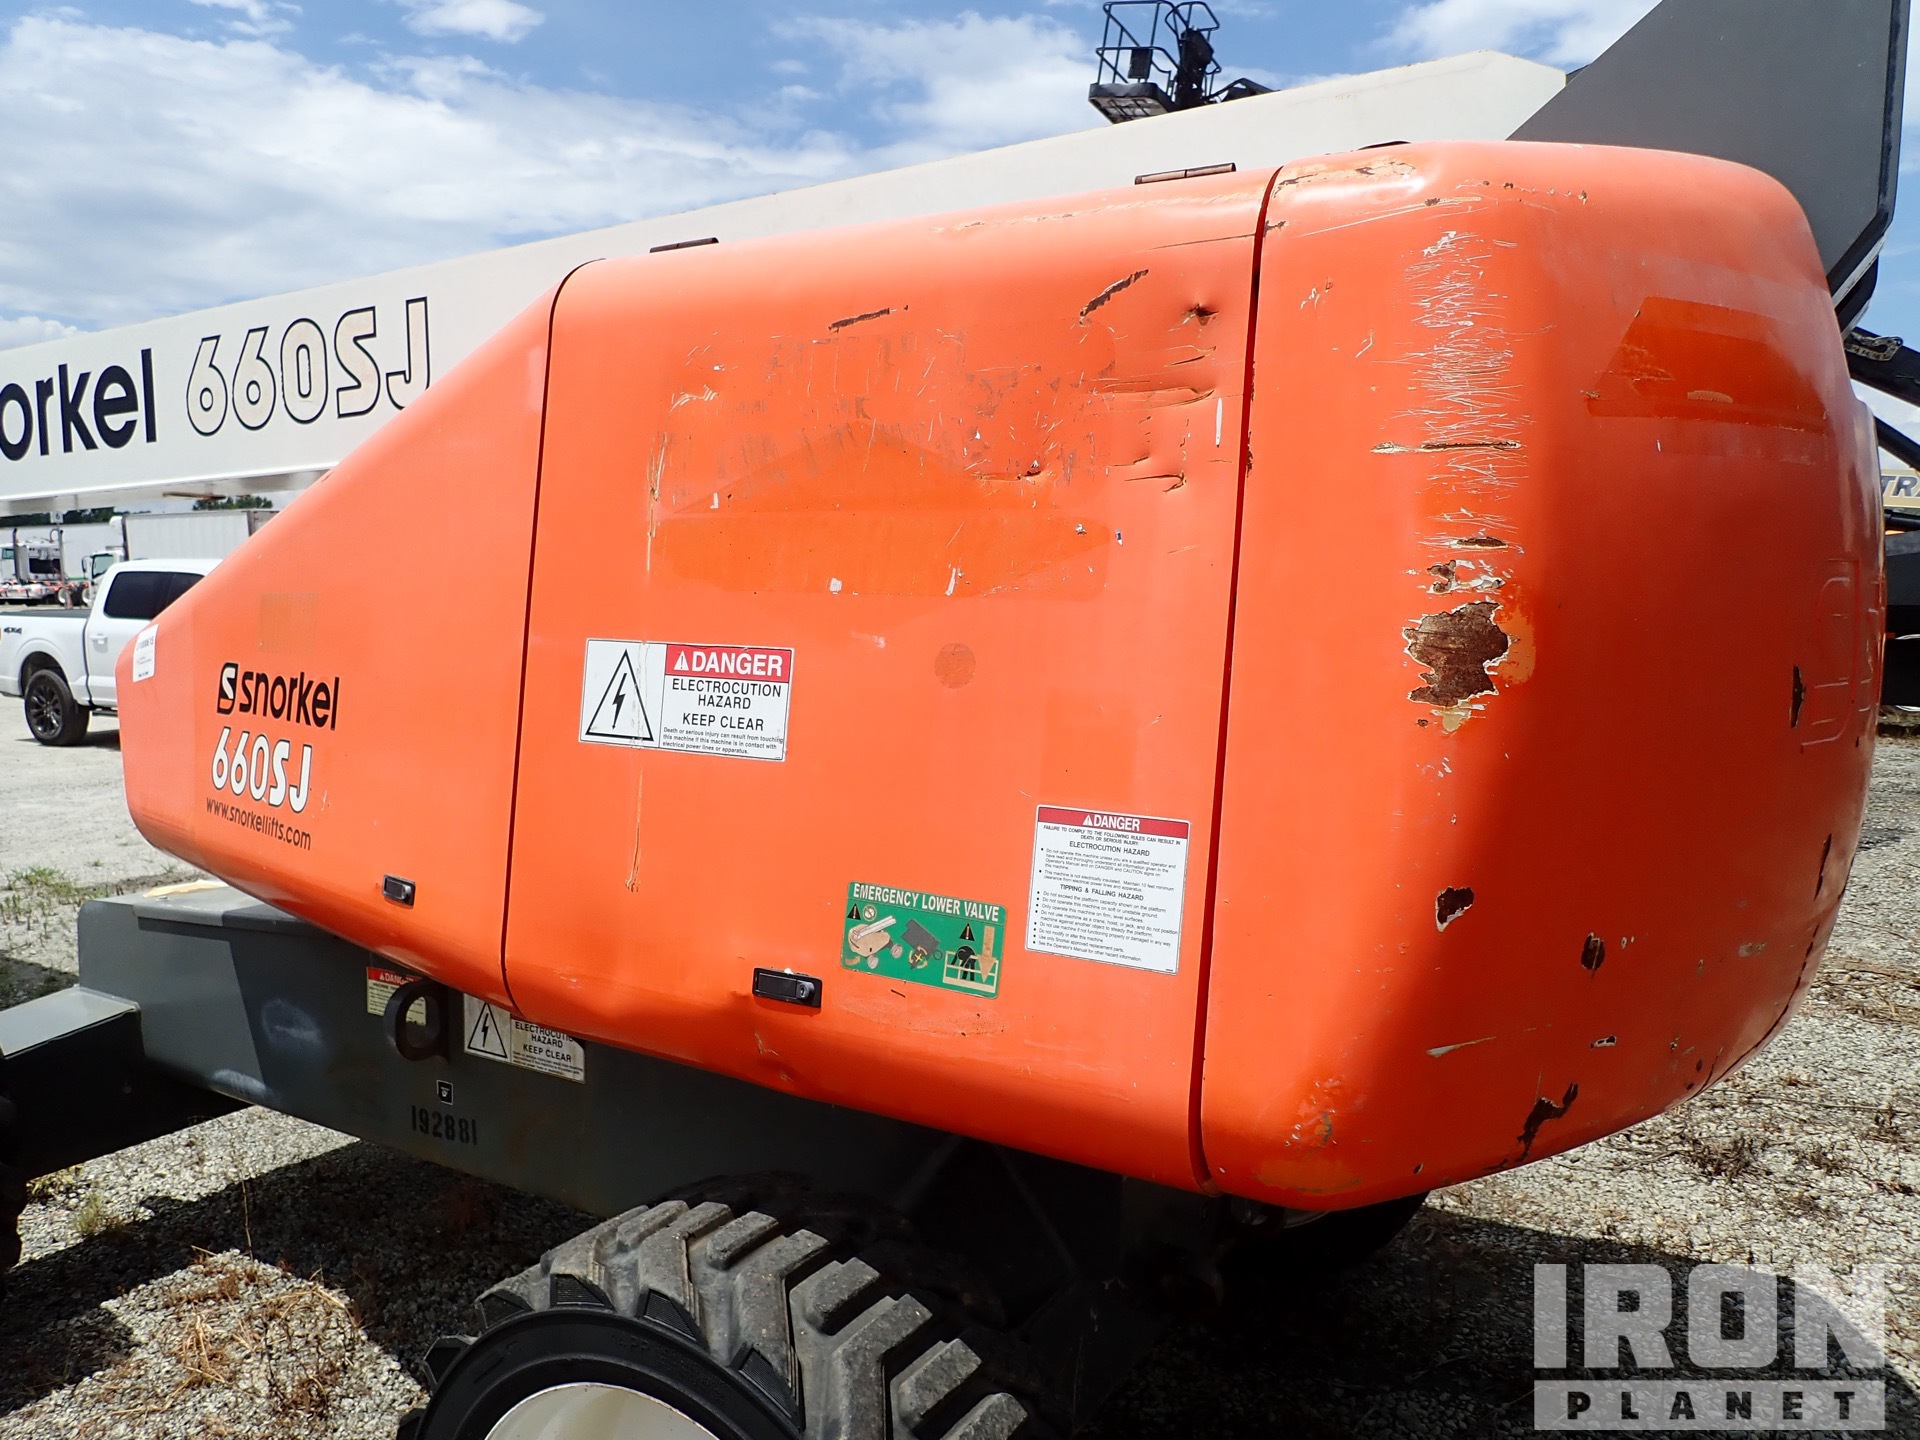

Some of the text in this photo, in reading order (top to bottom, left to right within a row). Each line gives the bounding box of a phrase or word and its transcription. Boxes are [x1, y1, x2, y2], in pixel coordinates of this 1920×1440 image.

[0, 296, 430, 461] orkel 660SJ
[1881, 476, 1920, 497] TR
[692, 650, 783, 676] DANGER
[672, 678, 782, 697] ELECTROCUTION
[239, 671, 340, 731] snorkel
[698, 694, 751, 709] HAZARD
[682, 712, 764, 731] KEEP CLEAR
[211, 726, 313, 814] 660SJ
[206, 797, 312, 851] www.snorkellifts.com
[1093, 814, 1140, 832] DANGER
[1069, 840, 1149, 856] ELECTROCUTION HAZARD
[853, 883, 1000, 922] EMERGENCY LOWER VALVE
[1060, 884, 1082, 892] TIPPING
[1091, 888, 1116, 896] FALLING
[1118, 891, 1143, 900] HAZARD
[515, 1021, 574, 1042] ELECTROCUT
[531, 1034, 563, 1048] HAZARD
[523, 1043, 572, 1062] KEEP CLEAR
[411, 1105, 477, 1146] 192881
